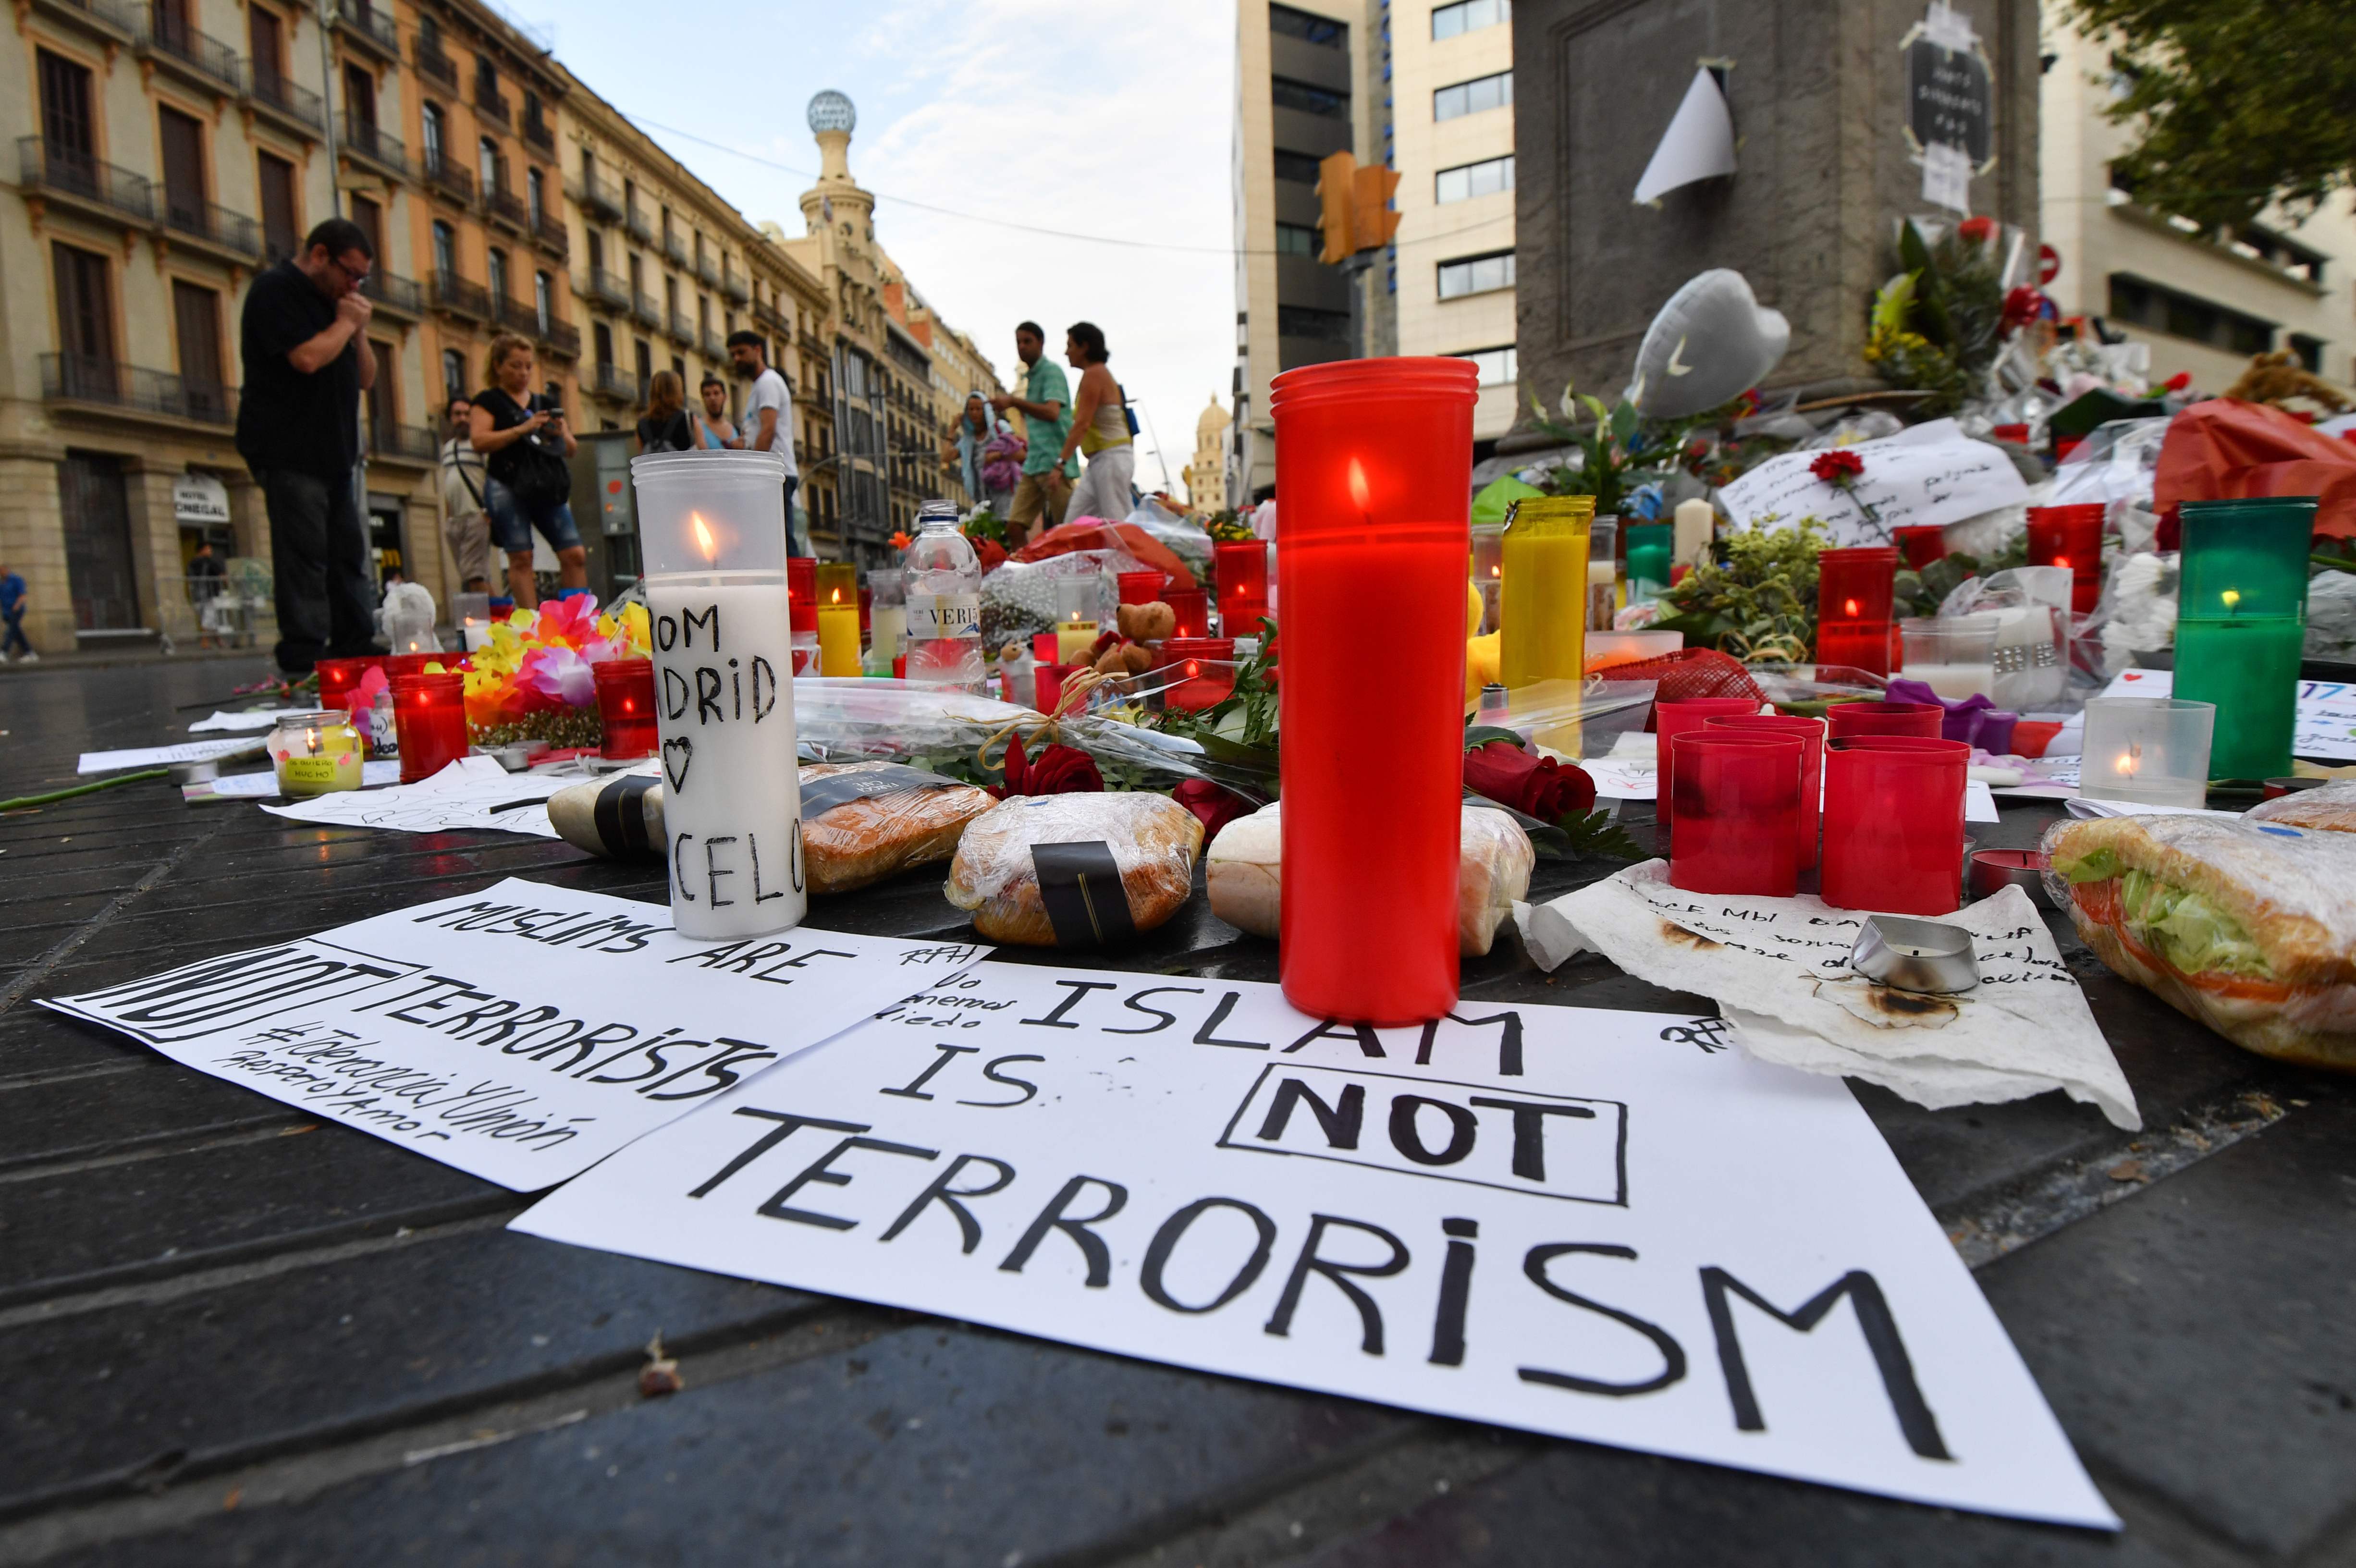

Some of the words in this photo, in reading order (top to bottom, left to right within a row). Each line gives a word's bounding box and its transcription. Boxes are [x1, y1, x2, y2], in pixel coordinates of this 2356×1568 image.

[73, 948, 402, 1030] NOT
[665, 940, 858, 985] ARE
[1019, 980, 1524, 1076] ISLAM
[880, 1043, 1046, 1107] IS
[1255, 1078, 1596, 1182] NOT
